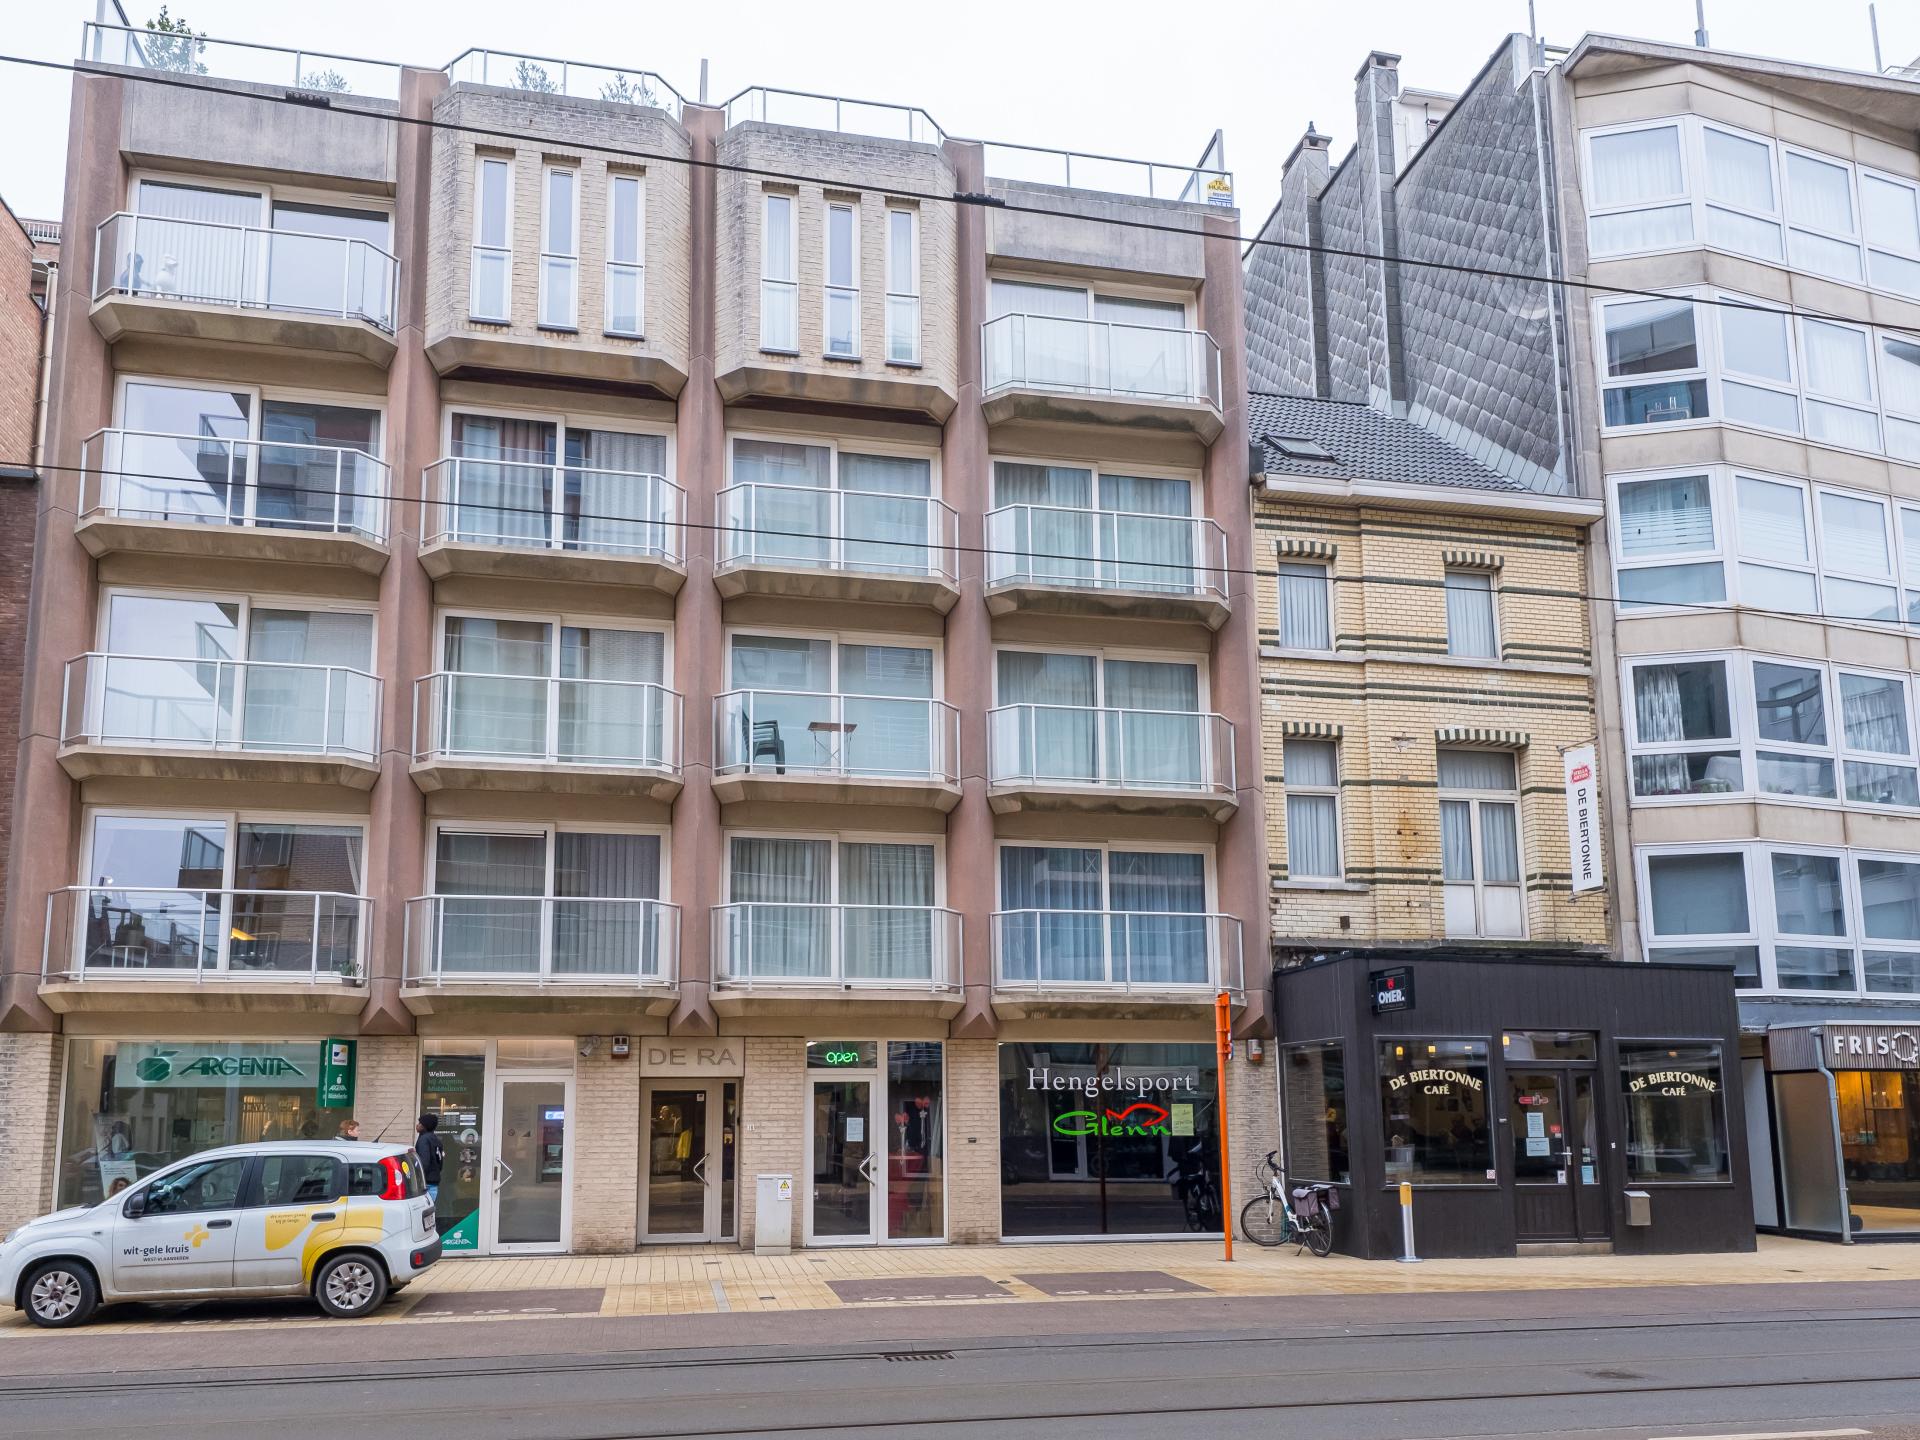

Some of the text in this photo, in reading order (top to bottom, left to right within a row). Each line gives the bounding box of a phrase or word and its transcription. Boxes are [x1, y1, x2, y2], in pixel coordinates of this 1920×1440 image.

[1577, 788, 1592, 881] DE BIERTONNE
[177, 1056, 307, 1077] ARGENTA
[648, 1048, 737, 1066] DE RA
[1026, 1067, 1194, 1098] Hengelsport
[1389, 1069, 1483, 1091] DE BIERTONNE
[1423, 1084, 1450, 1095] CAFÉ
[1629, 1071, 1717, 1092] DE BIERTONNE
[1661, 1085, 1687, 1096] CAFÉ
[1053, 1110, 1172, 1136] Glenn
[123, 1244, 190, 1256] wit-gele kruis
